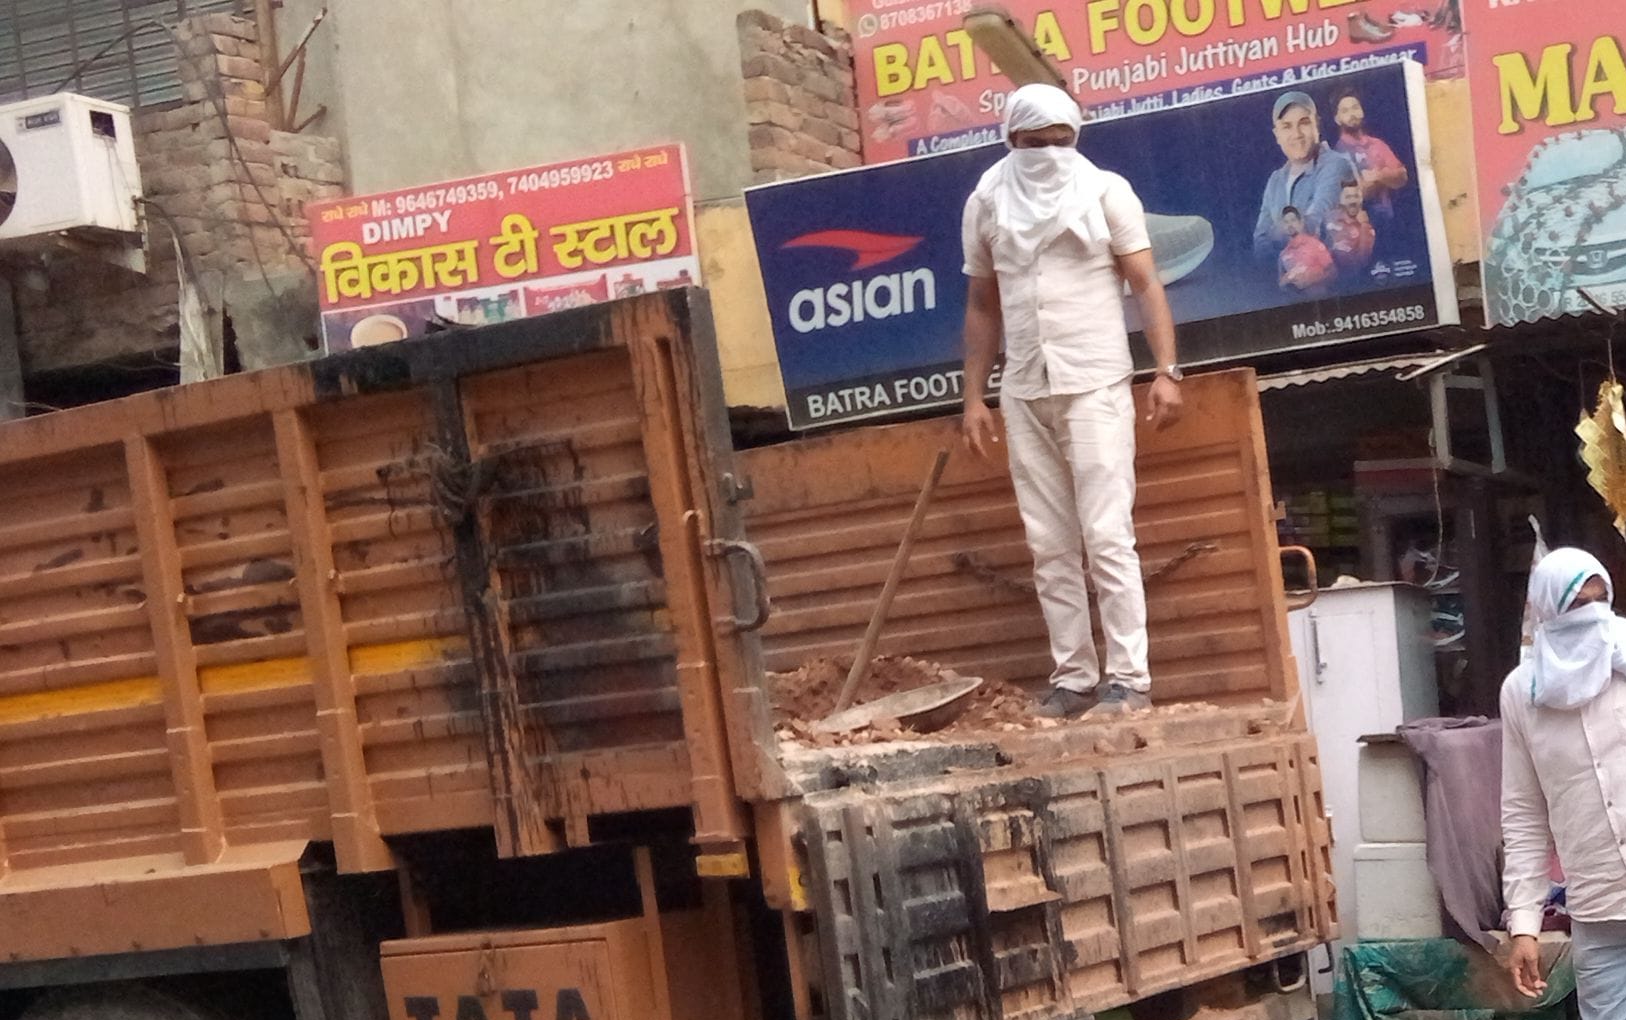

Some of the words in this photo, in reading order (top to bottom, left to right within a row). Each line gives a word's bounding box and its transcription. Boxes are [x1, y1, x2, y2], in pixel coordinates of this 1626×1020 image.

[873, 11, 1072, 97] BATA
[1072, 52, 1167, 95] Punjabi
[1175, 32, 1280, 75] Juttiyan
[1287, 21, 1339, 54] Hub
[916, 139, 928, 155] A
[930, 130, 998, 152] Complete
[1300, 63, 1336, 83] Kids
[372, 199, 392, 218] M:
[507, 160, 614, 195] 7404959923
[320, 238, 480, 304] विकास
[489, 213, 539, 279] टी
[549, 206, 680, 270] स्टाल
[362, 209, 452, 245] DIMPY
[788, 263, 936, 334] asian
[807, 383, 892, 419] BATRA
